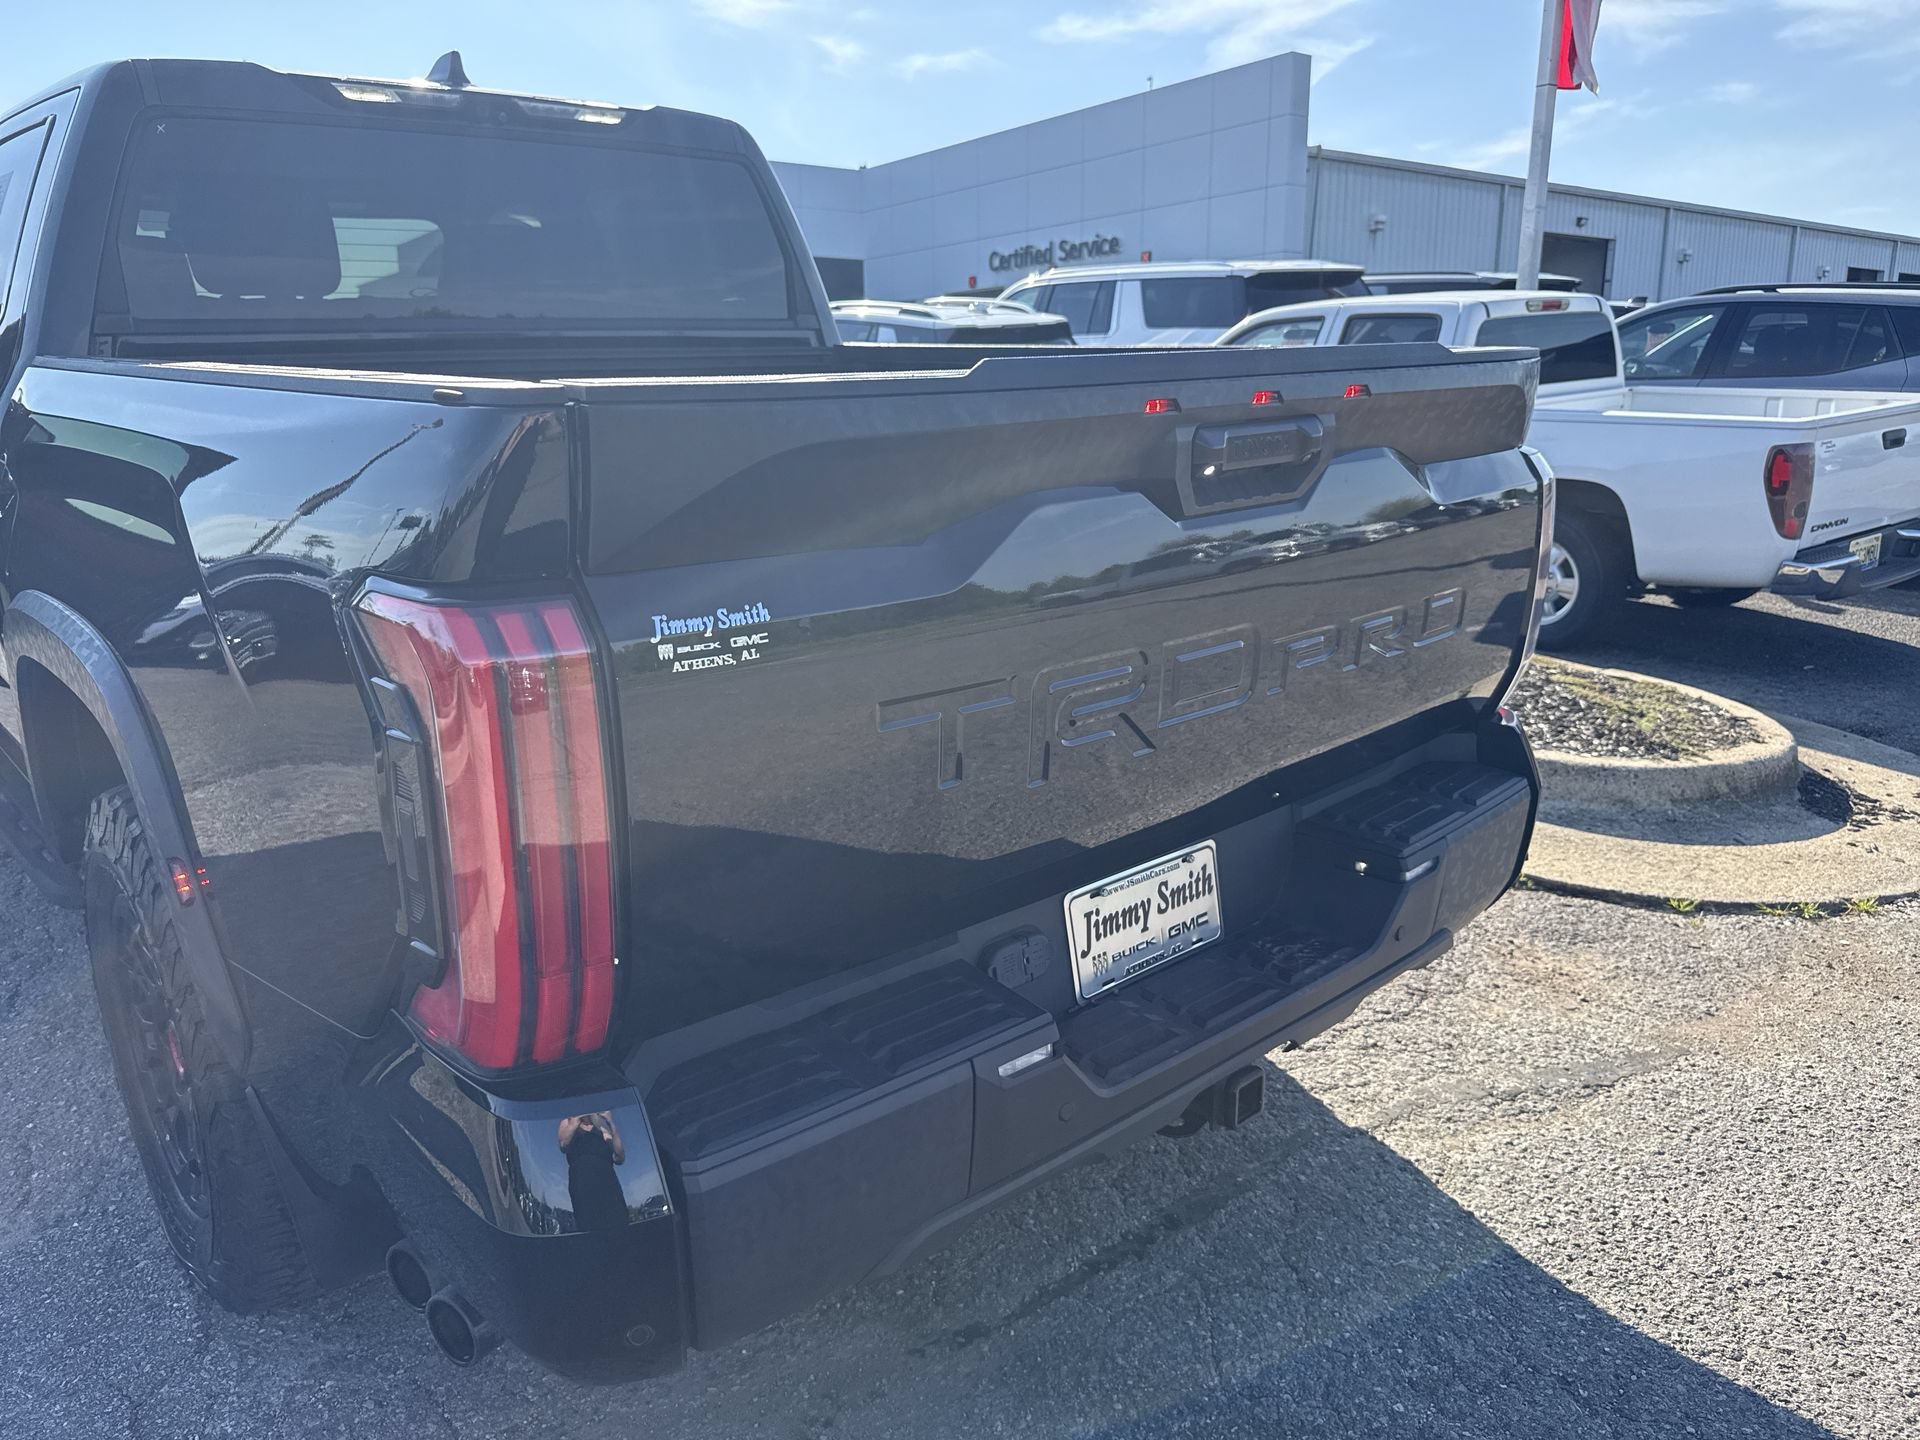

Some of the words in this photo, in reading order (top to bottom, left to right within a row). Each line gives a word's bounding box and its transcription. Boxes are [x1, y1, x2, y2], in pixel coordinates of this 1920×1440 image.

[989, 241, 1055, 272] Certified
[1057, 234, 1120, 262] Service
[1810, 517, 1849, 533] CANYON
[650, 614, 714, 643] Jimmy
[716, 601, 771, 629] Smith
[672, 653, 737, 673] ATHENS,
[741, 648, 760, 661] AL
[677, 641, 722, 654] BUICK
[730, 632, 769, 648] GMC
[1080, 897, 1152, 960] Jimmy
[1157, 864, 1214, 915] Smith
[1111, 936, 1157, 963] BUICK
[1168, 911, 1209, 939] GMC
